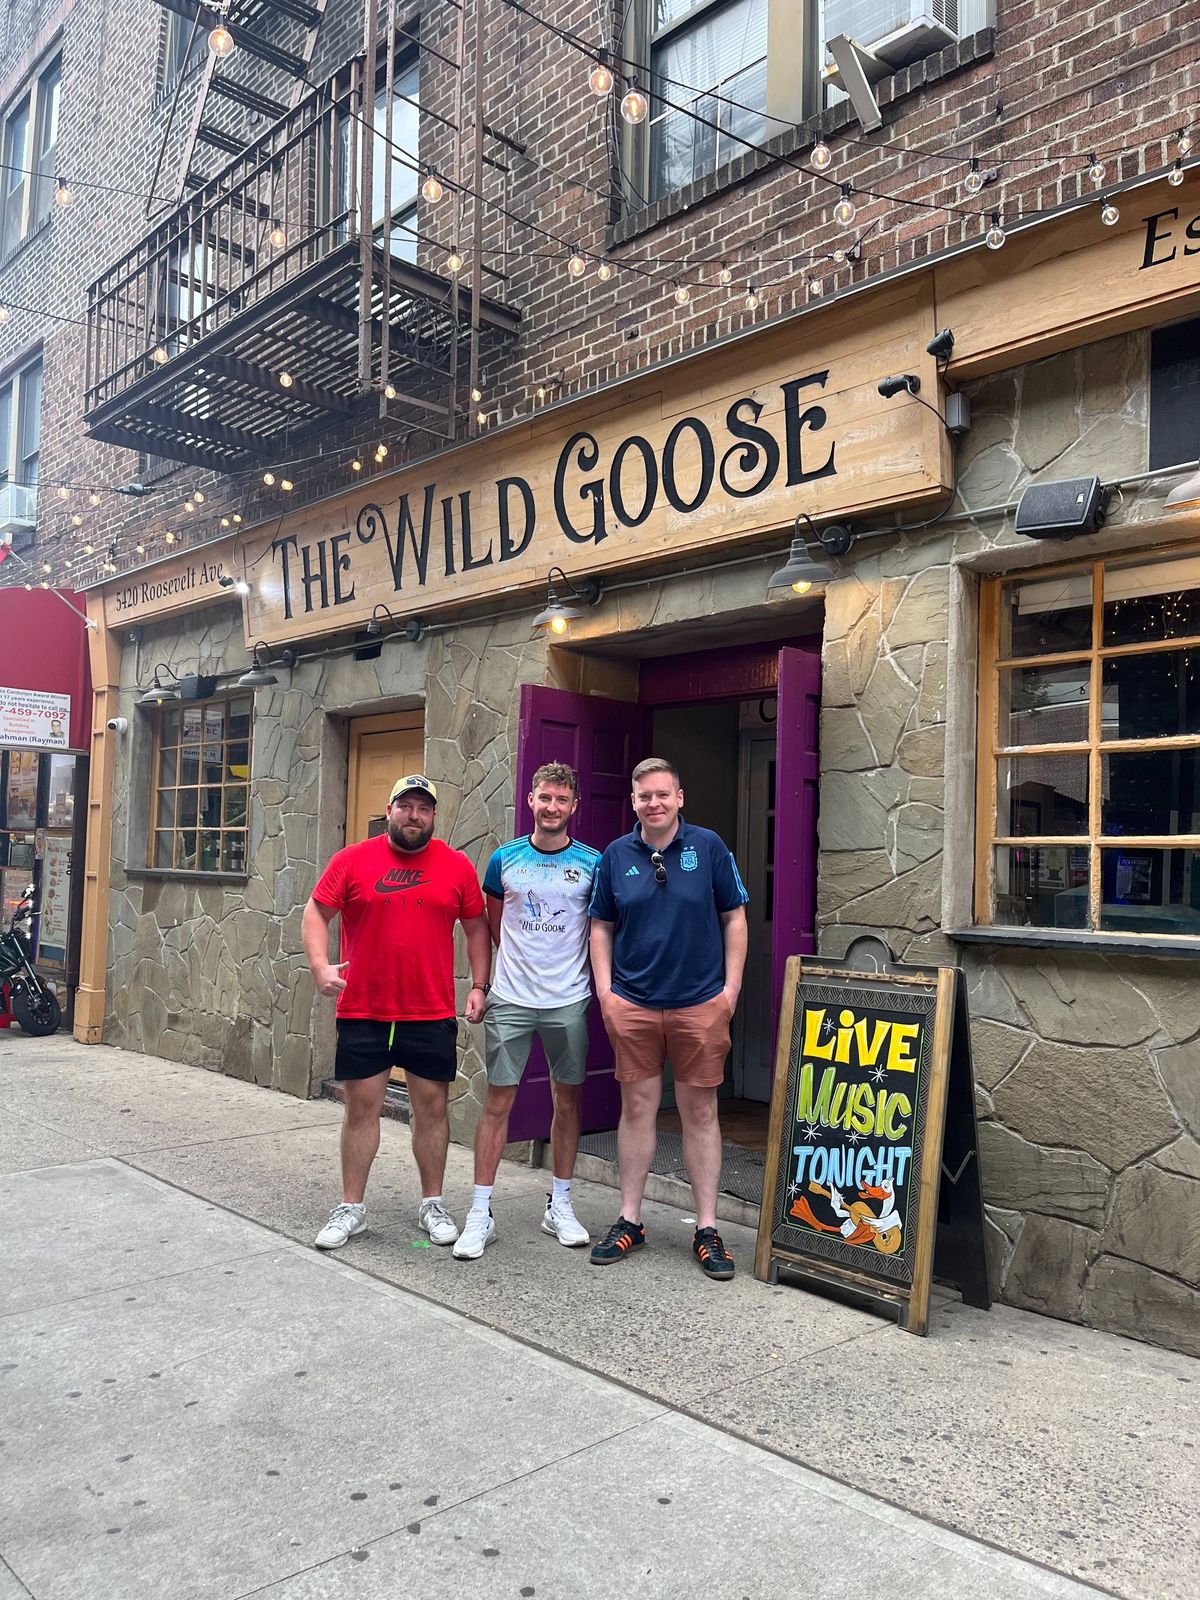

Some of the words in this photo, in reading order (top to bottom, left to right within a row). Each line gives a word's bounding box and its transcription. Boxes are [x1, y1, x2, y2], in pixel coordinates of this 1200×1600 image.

[271, 534, 356, 621] THE
[356, 475, 536, 591] WILD
[553, 369, 838, 546] GOOSE
[116, 585, 138, 612] 5420
[141, 566, 197, 604] Roosevelt
[199, 561, 224, 586] Ave
[18, 702, 41, 710] hesitate
[384, 868, 425, 884] NIKE
[383, 896, 424, 907] AIR
[519, 919, 541, 931] WILD
[541, 922, 566, 933] GOOSE
[803, 1009, 920, 1073] LiVE
[797, 1062, 913, 1141] MUSIC
[793, 1144, 912, 1189] TONIGHT
